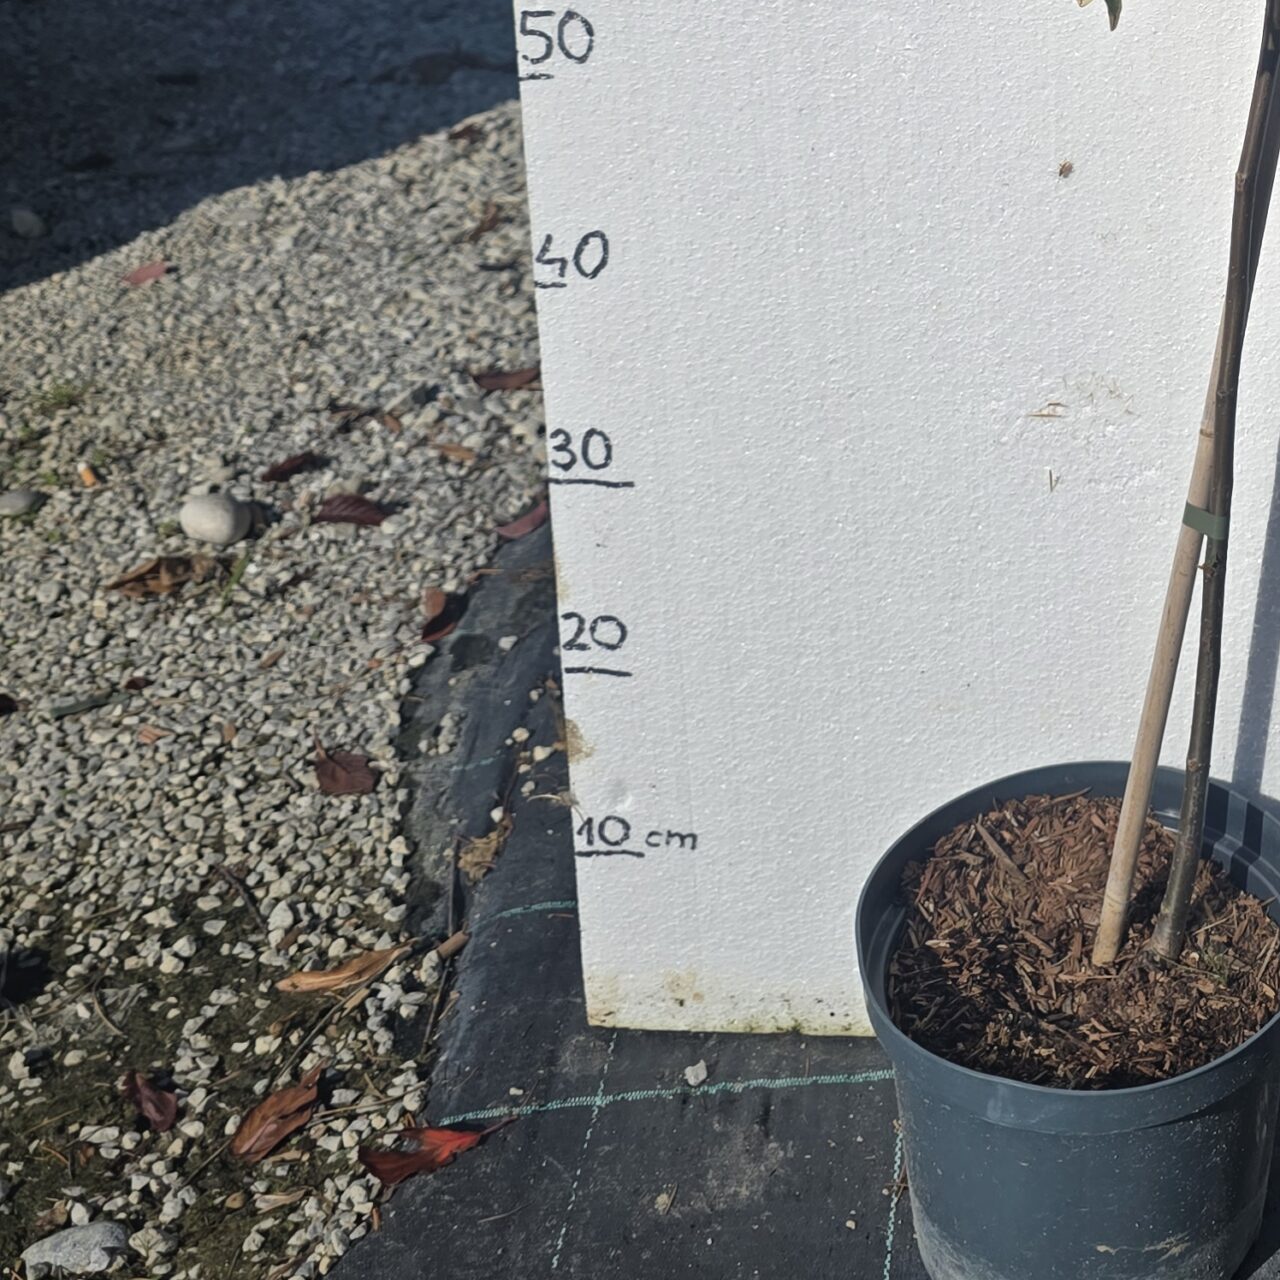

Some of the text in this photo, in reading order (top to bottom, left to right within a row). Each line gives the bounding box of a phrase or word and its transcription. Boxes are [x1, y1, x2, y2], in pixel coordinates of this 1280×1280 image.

[520, 9, 595, 64] 50
[535, 230, 609, 279] 40
[550, 427, 613, 472] 30
[561, 611, 628, 651] 20
[577, 815, 698, 851] 10 cm
